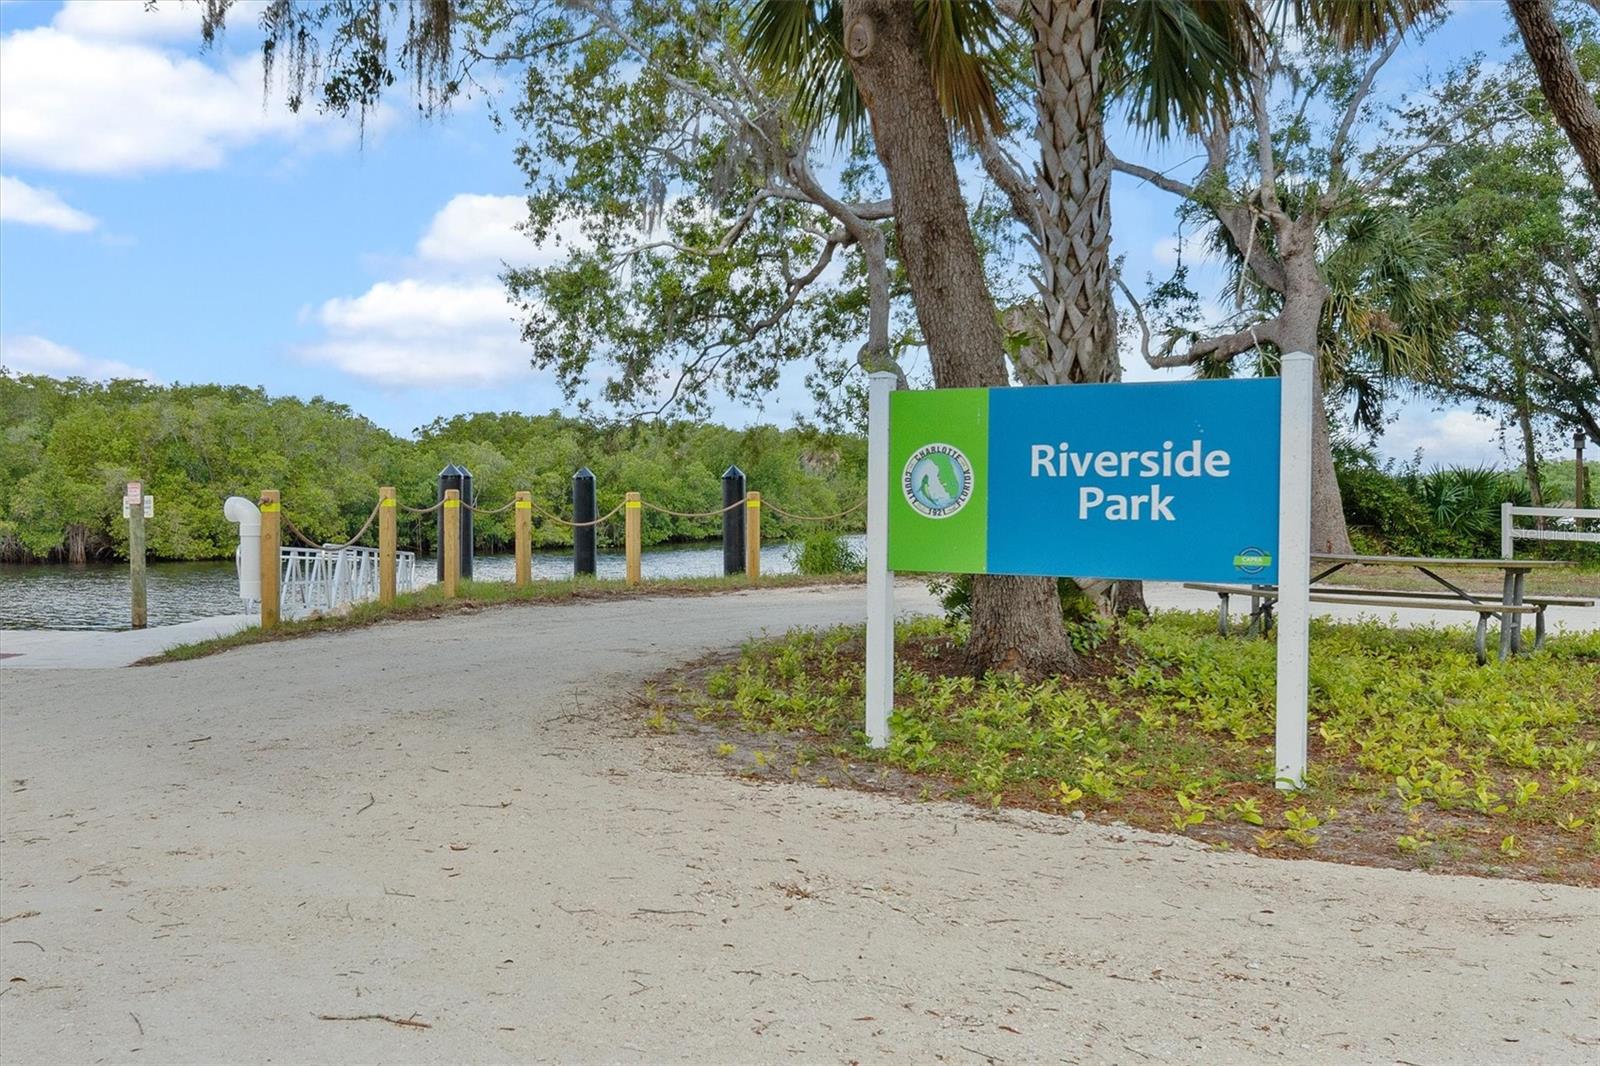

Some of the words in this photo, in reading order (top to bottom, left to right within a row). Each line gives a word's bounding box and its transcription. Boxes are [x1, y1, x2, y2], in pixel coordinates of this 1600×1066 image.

[914, 446, 961, 461] CHARLOTTE
[1030, 440, 1231, 478] Riverside
[904, 471, 918, 505] COUNTY
[956, 469, 972, 507] FLORIDA
[1079, 484, 1176, 521] Park
[928, 508, 946, 516] 1921
